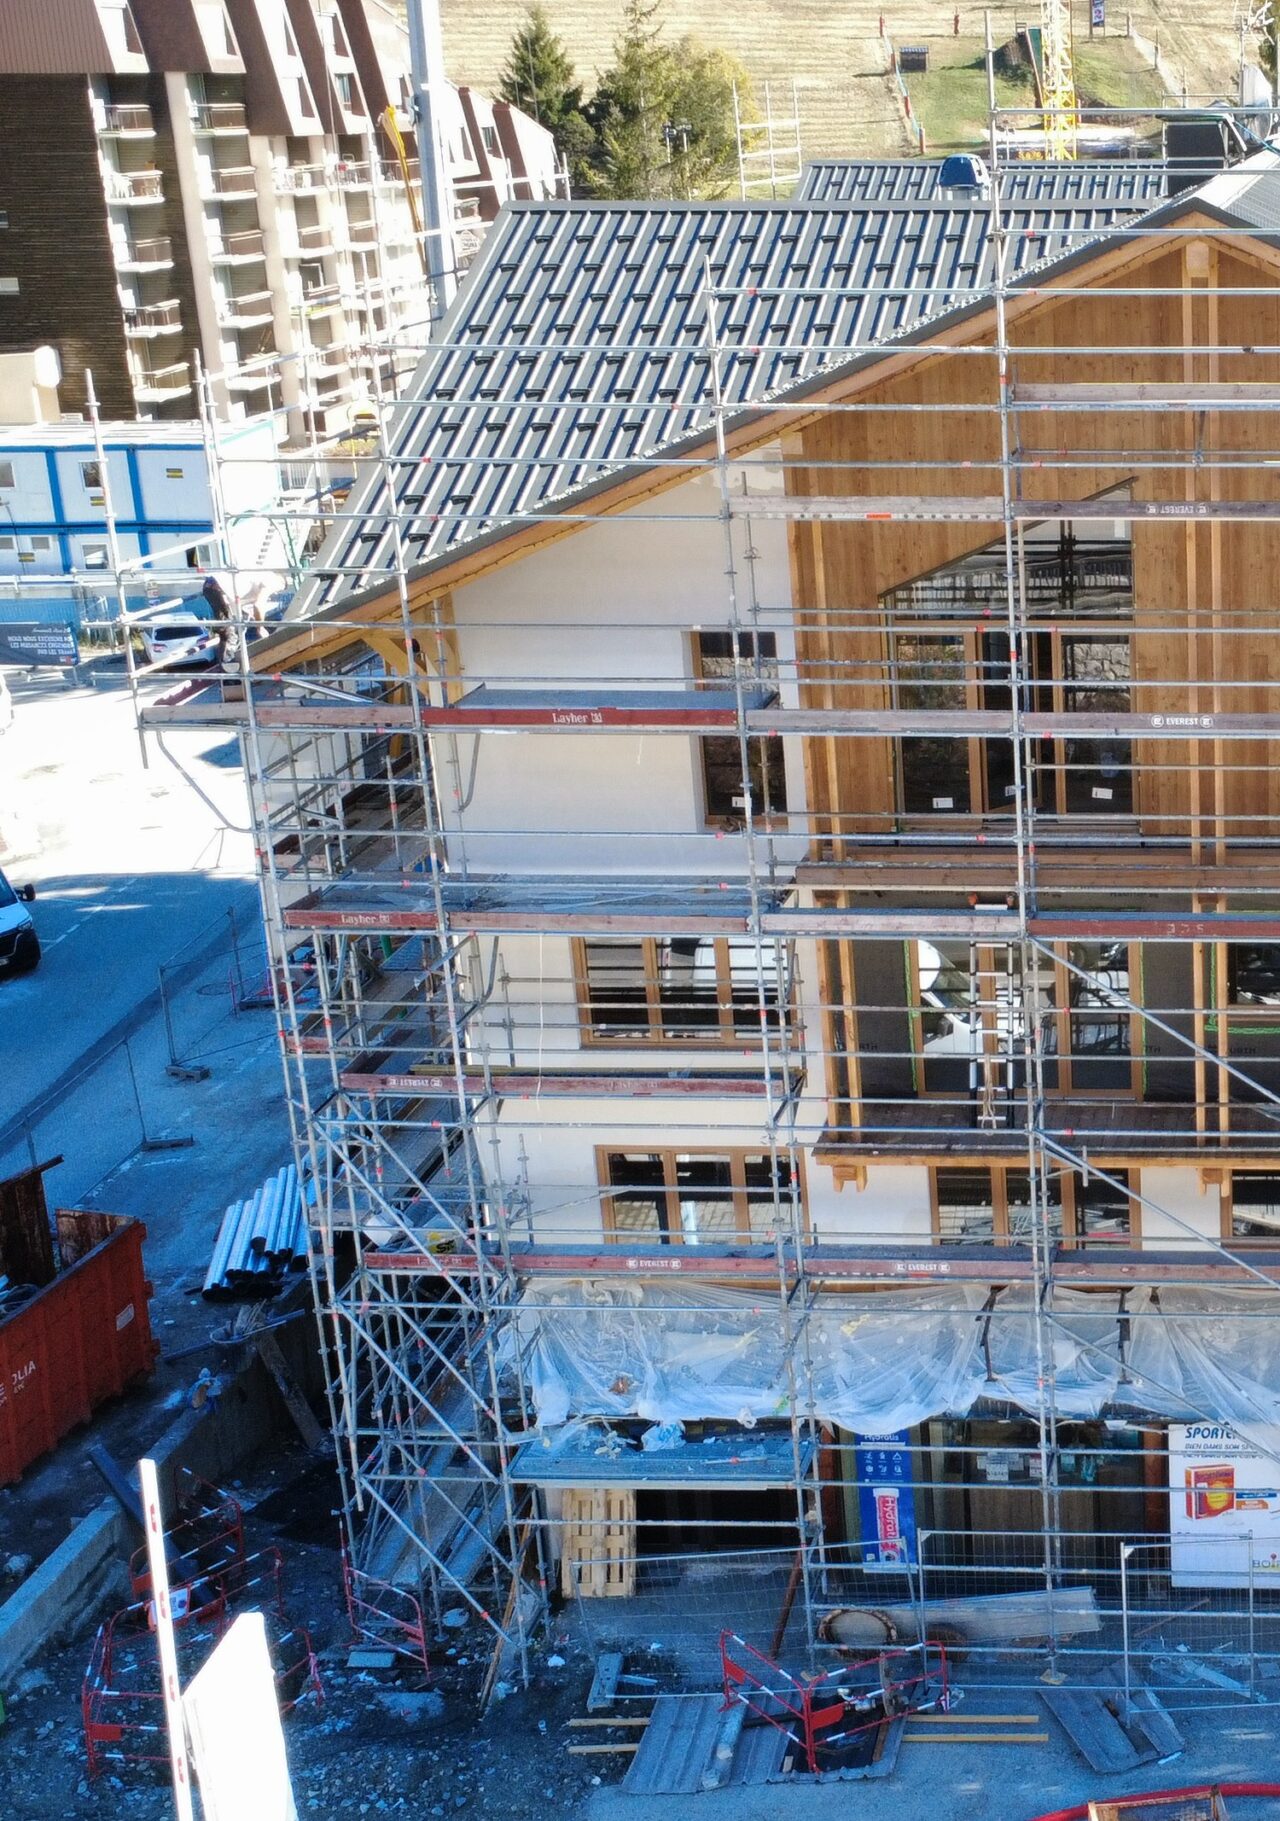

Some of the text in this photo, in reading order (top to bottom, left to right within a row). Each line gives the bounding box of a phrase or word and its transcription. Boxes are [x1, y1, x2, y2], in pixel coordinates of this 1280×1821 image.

[552, 712, 588, 724] Layher
[1166, 717, 1199, 726] EVEREST
[639, 1259, 669, 1268] EVEREST
[908, 1263, 938, 1271] EVEREST
